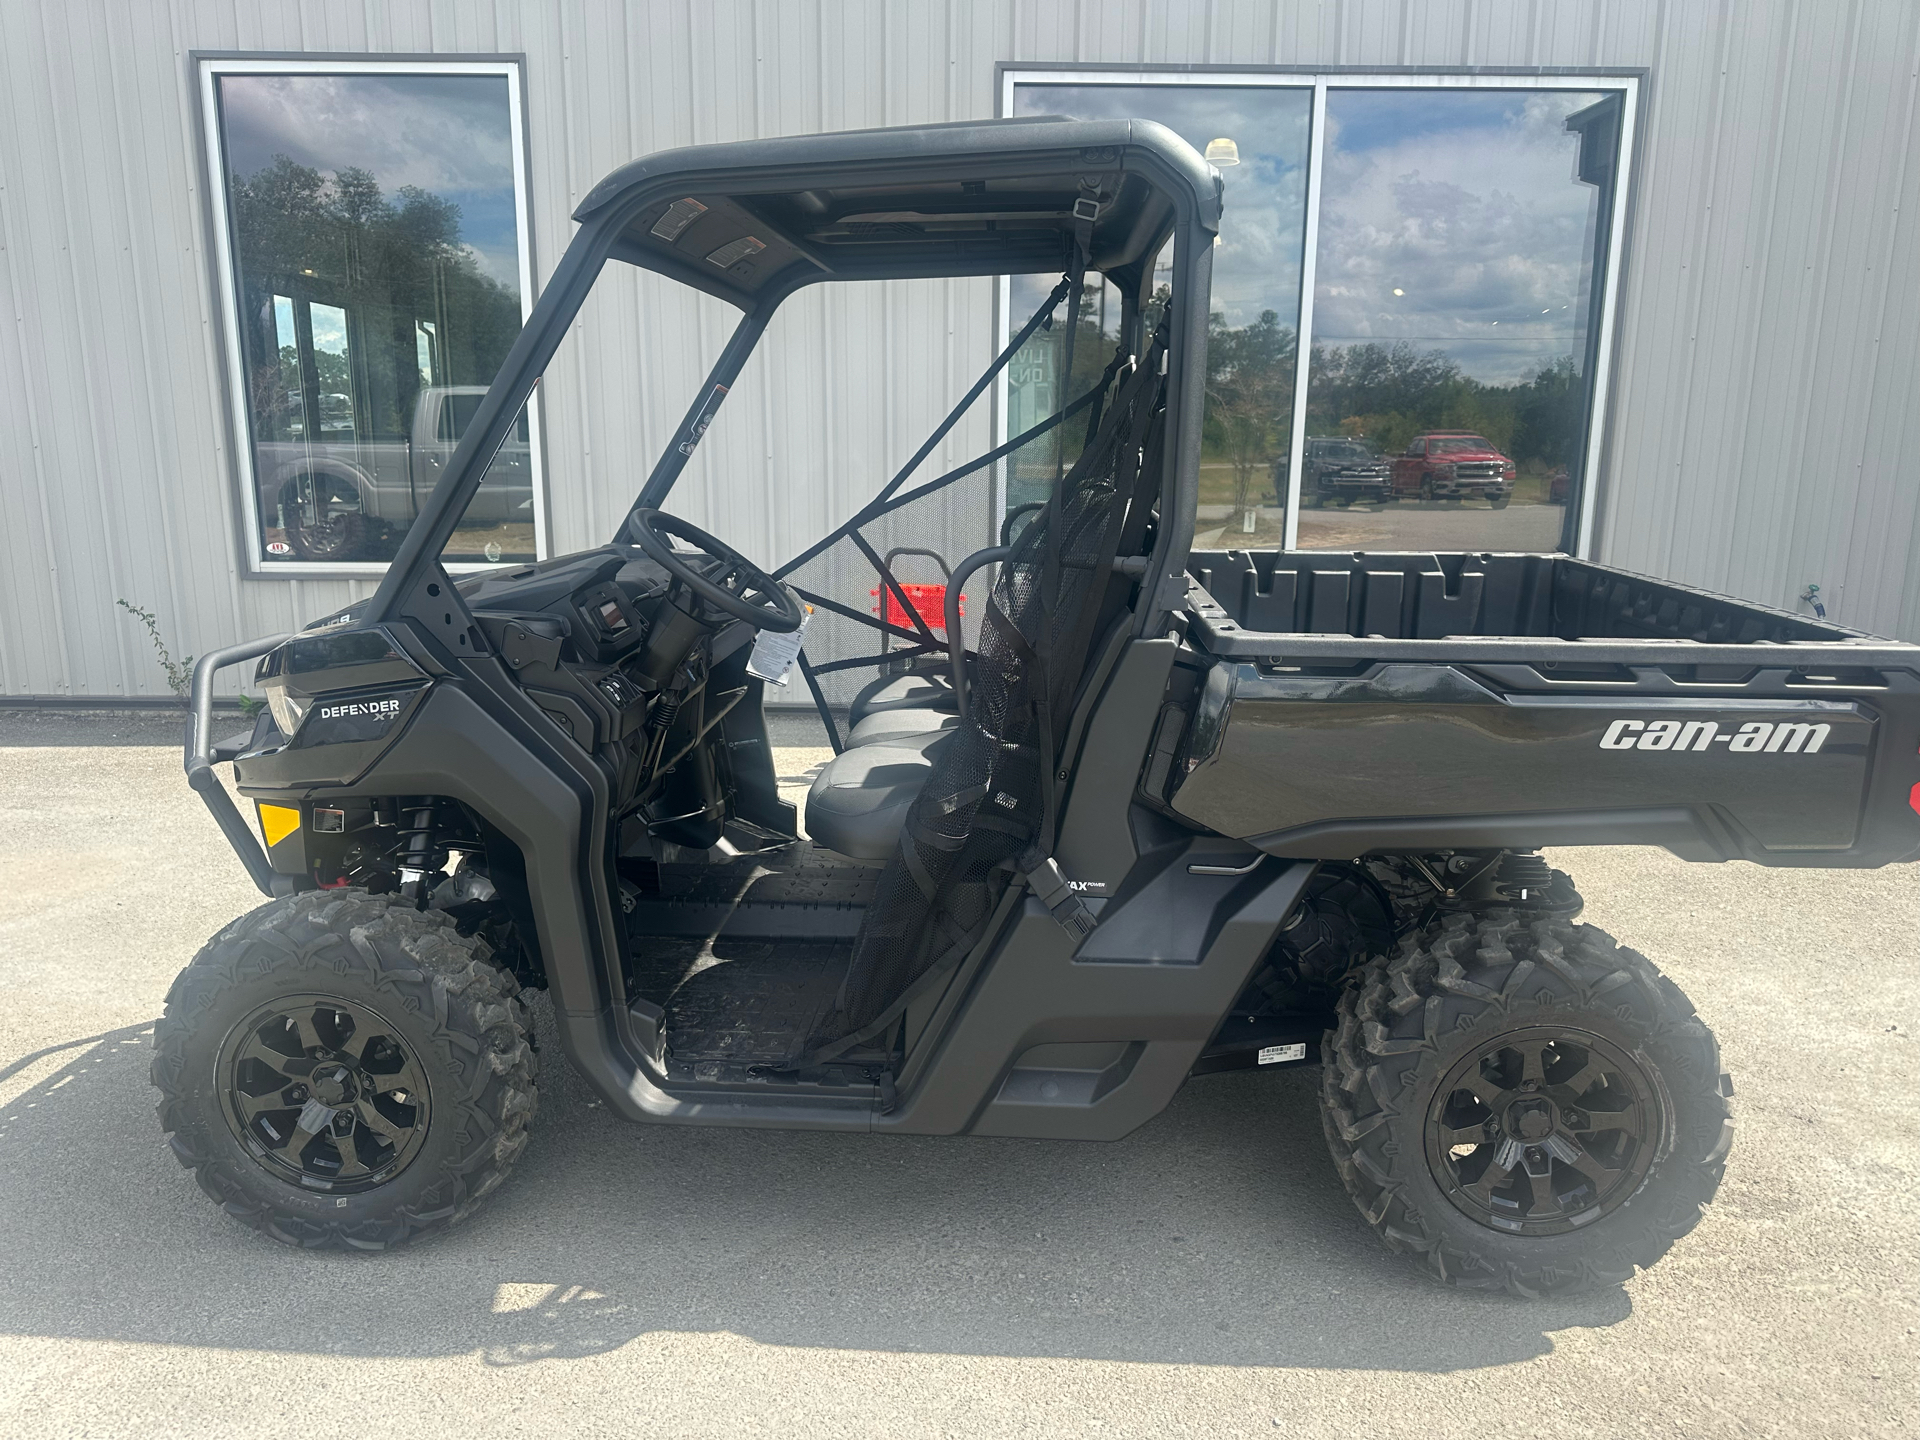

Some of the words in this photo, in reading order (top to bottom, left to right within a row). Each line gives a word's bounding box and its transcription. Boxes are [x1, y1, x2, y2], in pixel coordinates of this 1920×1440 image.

[321, 699, 400, 719] DEFENDER
[372, 711, 400, 722] XT
[1599, 719, 1831, 754] can-am
[1067, 881, 1088, 891] AX
